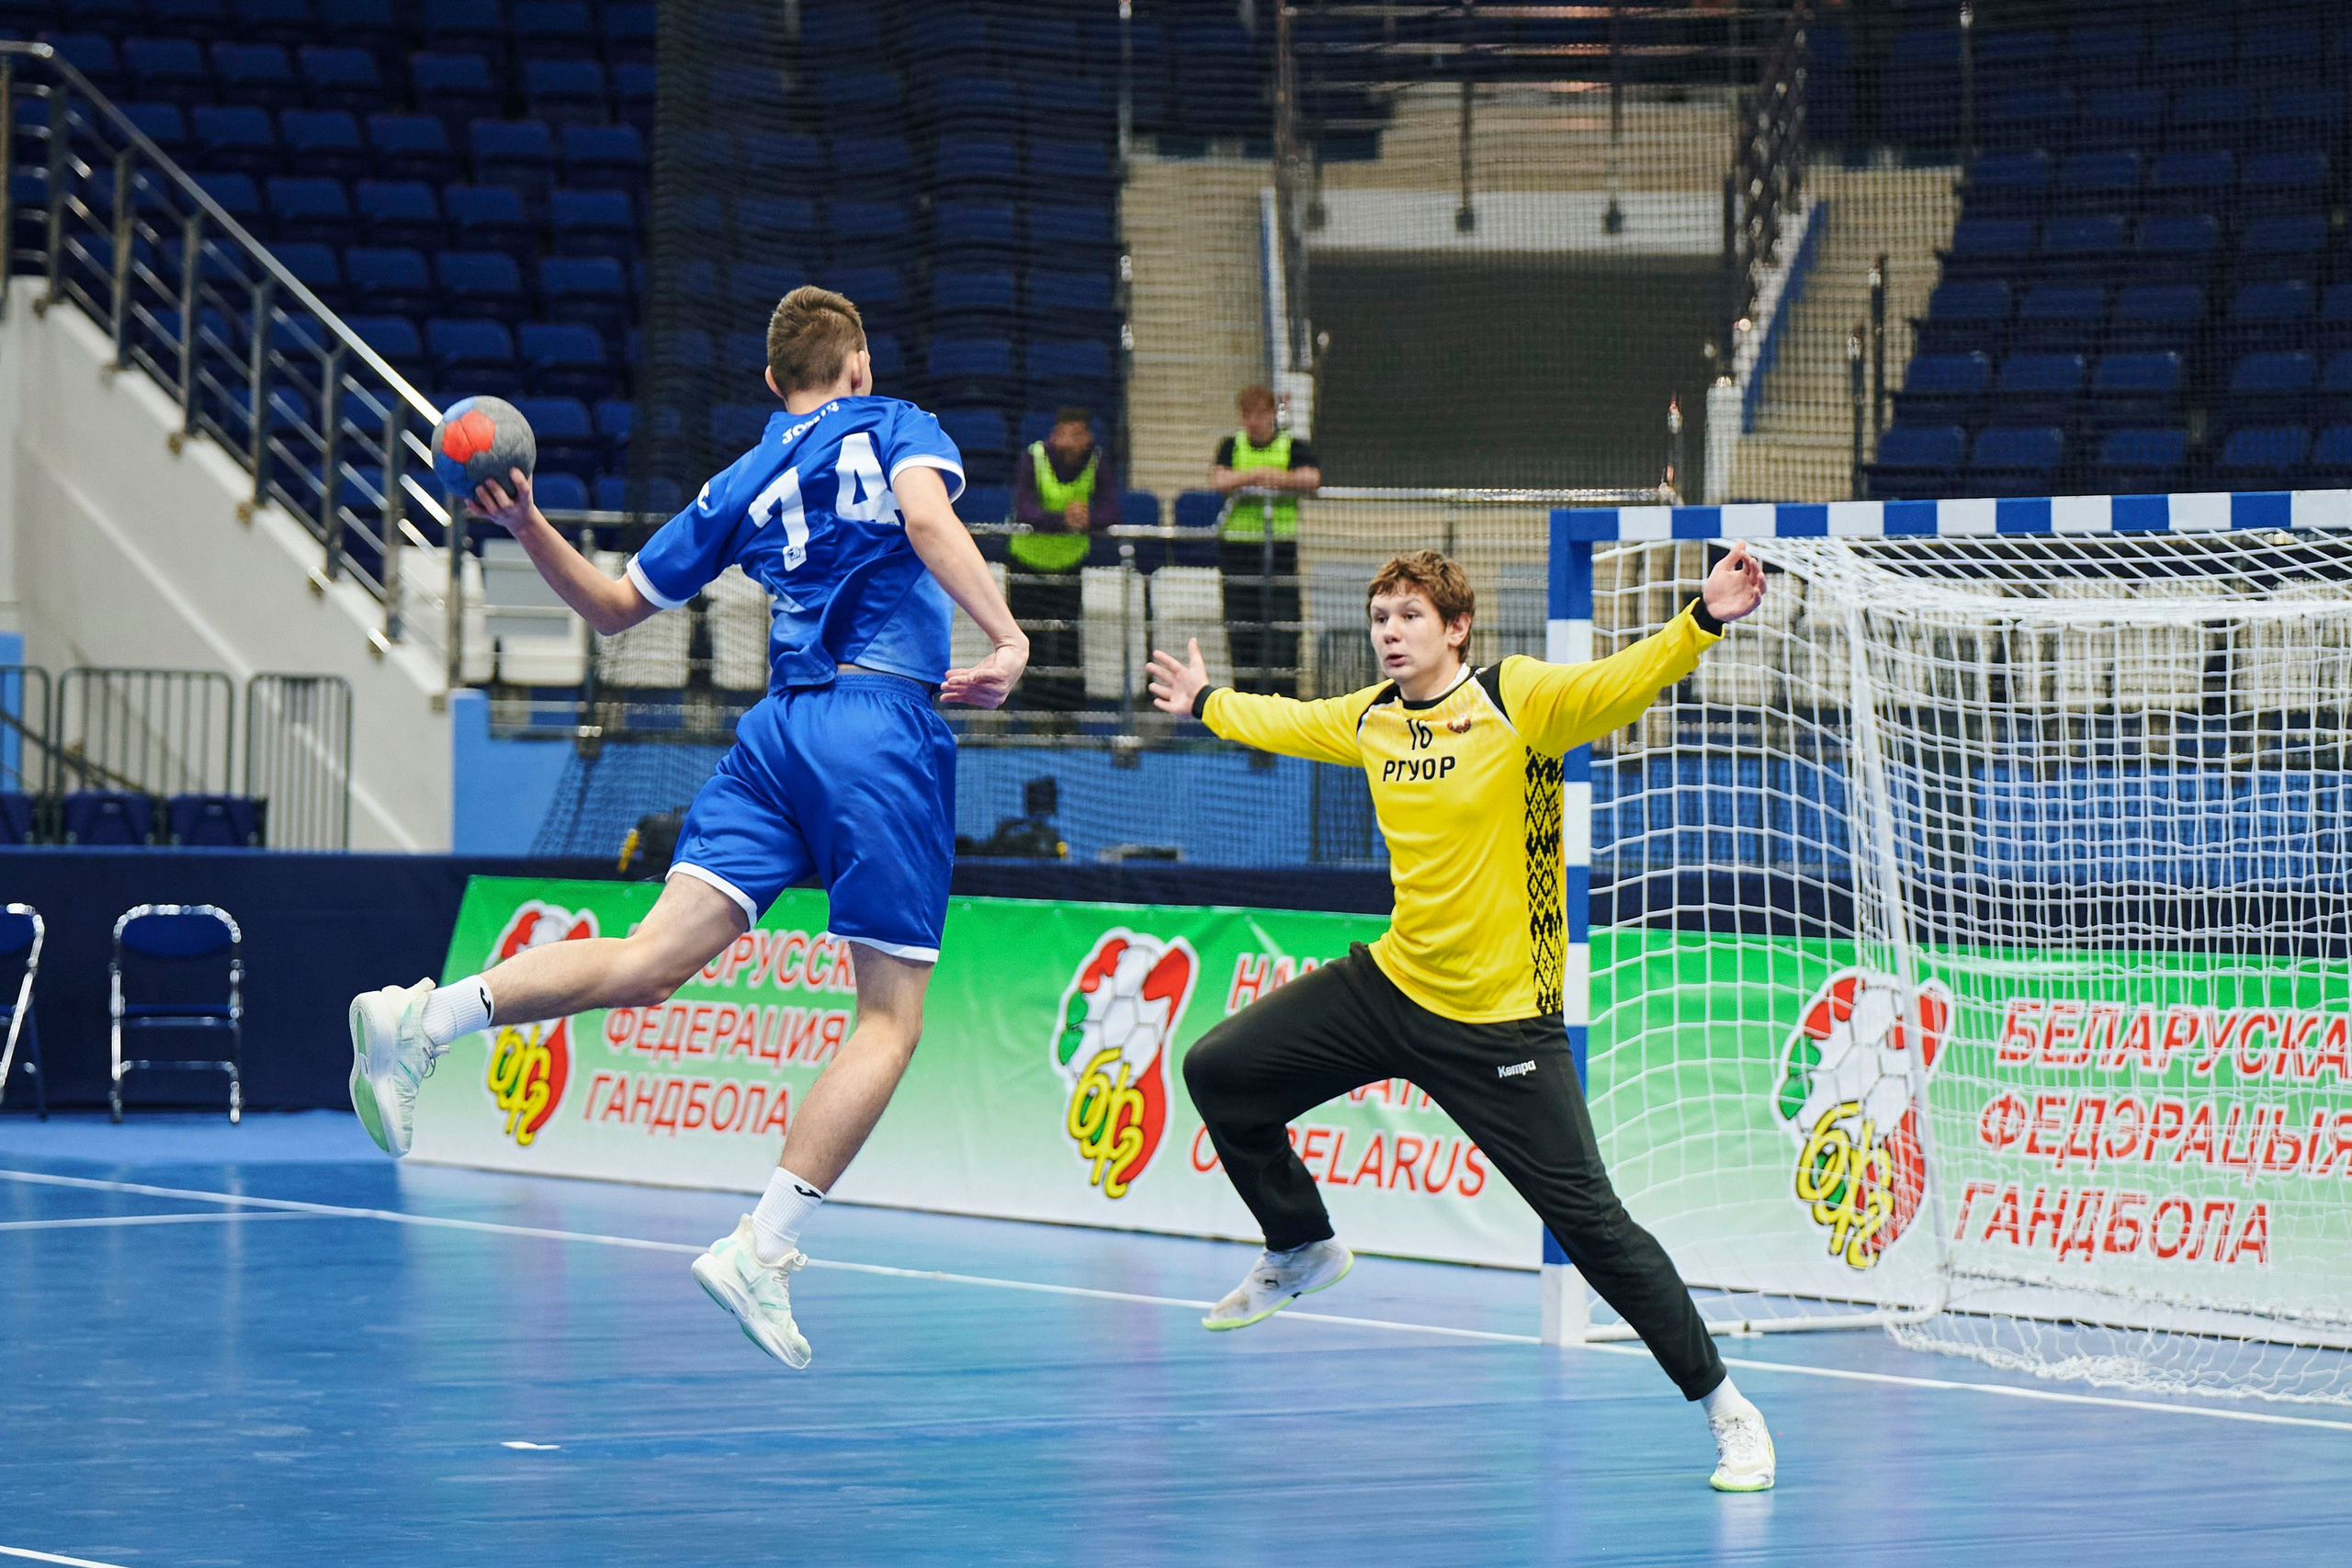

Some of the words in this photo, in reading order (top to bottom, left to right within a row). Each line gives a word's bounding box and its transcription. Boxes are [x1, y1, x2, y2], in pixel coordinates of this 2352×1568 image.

[1406, 717, 1433, 750] 16
[1382, 755, 1455, 782] РГУОР
[606, 1004, 846, 1068] ФЕДЕРАЦИЯ
[1497, 1059, 1537, 1078] Kempa
[582, 1076, 788, 1136] ГАНДБОЛА
[1288, 1126, 1487, 1196] ELARUS
[1953, 1182, 2271, 1265] ГАНДБОЛА
